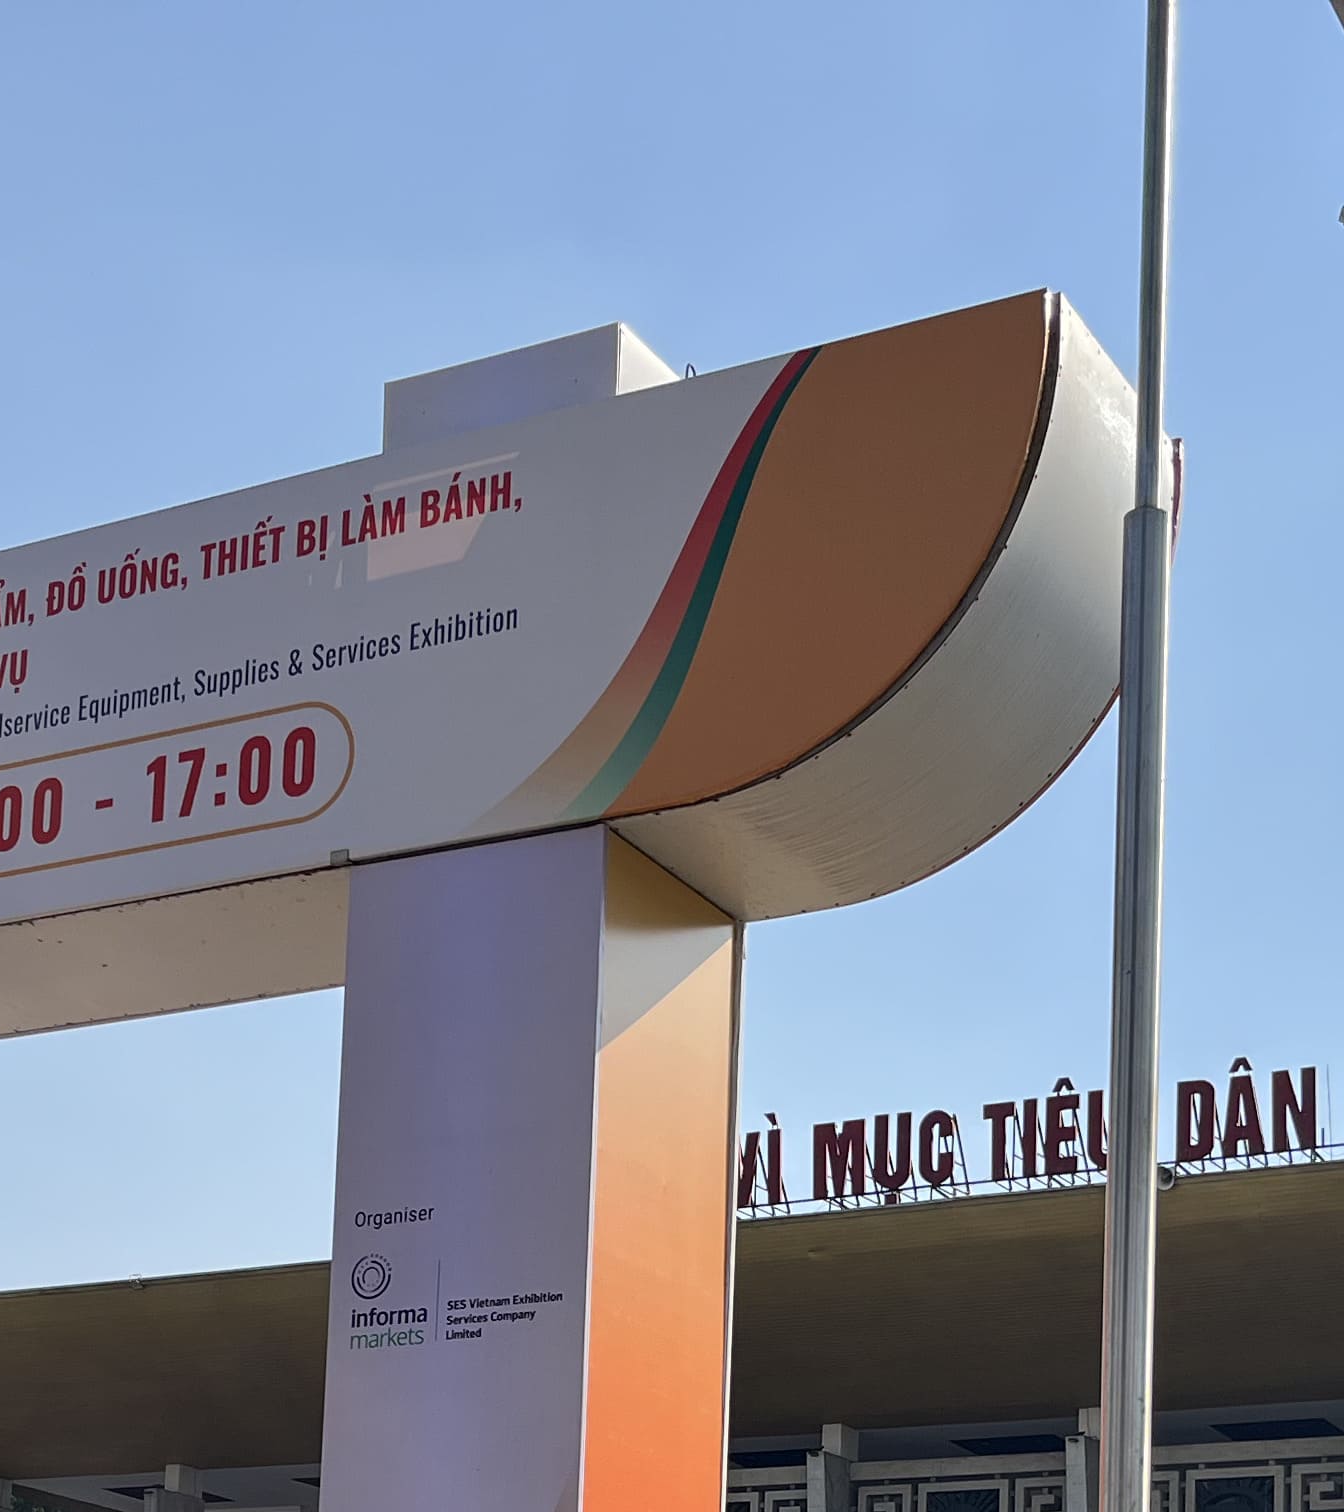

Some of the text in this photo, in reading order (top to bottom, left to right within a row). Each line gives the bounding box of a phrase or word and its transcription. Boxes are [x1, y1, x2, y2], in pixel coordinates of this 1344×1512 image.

[45, 561, 87, 618] ĐỒ
[96, 548, 188, 605] UỐNG,
[200, 516, 286, 580] THIẾT
[295, 516, 329, 561] BỊ
[341, 494, 406, 545] LÀM
[418, 471, 523, 529] BÁNH,
[77, 678, 186, 726] Equipment,
[193, 660, 280, 701] Supplies
[287, 650, 304, 675] &
[311, 634, 401, 671] Services
[409, 607, 520, 652] Exhibition
[95, 797, 114, 811] -
[146, 726, 316, 823] 17:00
[813, 1109, 955, 1204] MỤC
[1176, 1056, 1317, 1163] DÂN
[354, 1206, 434, 1230] Organiser
[447, 1291, 563, 1311] SES Vietnam Exhibition
[351, 1306, 428, 1328] informa
[446, 1309, 536, 1326] Services Company
[350, 1327, 424, 1349] markets
[446, 1328, 482, 1340] Limited
